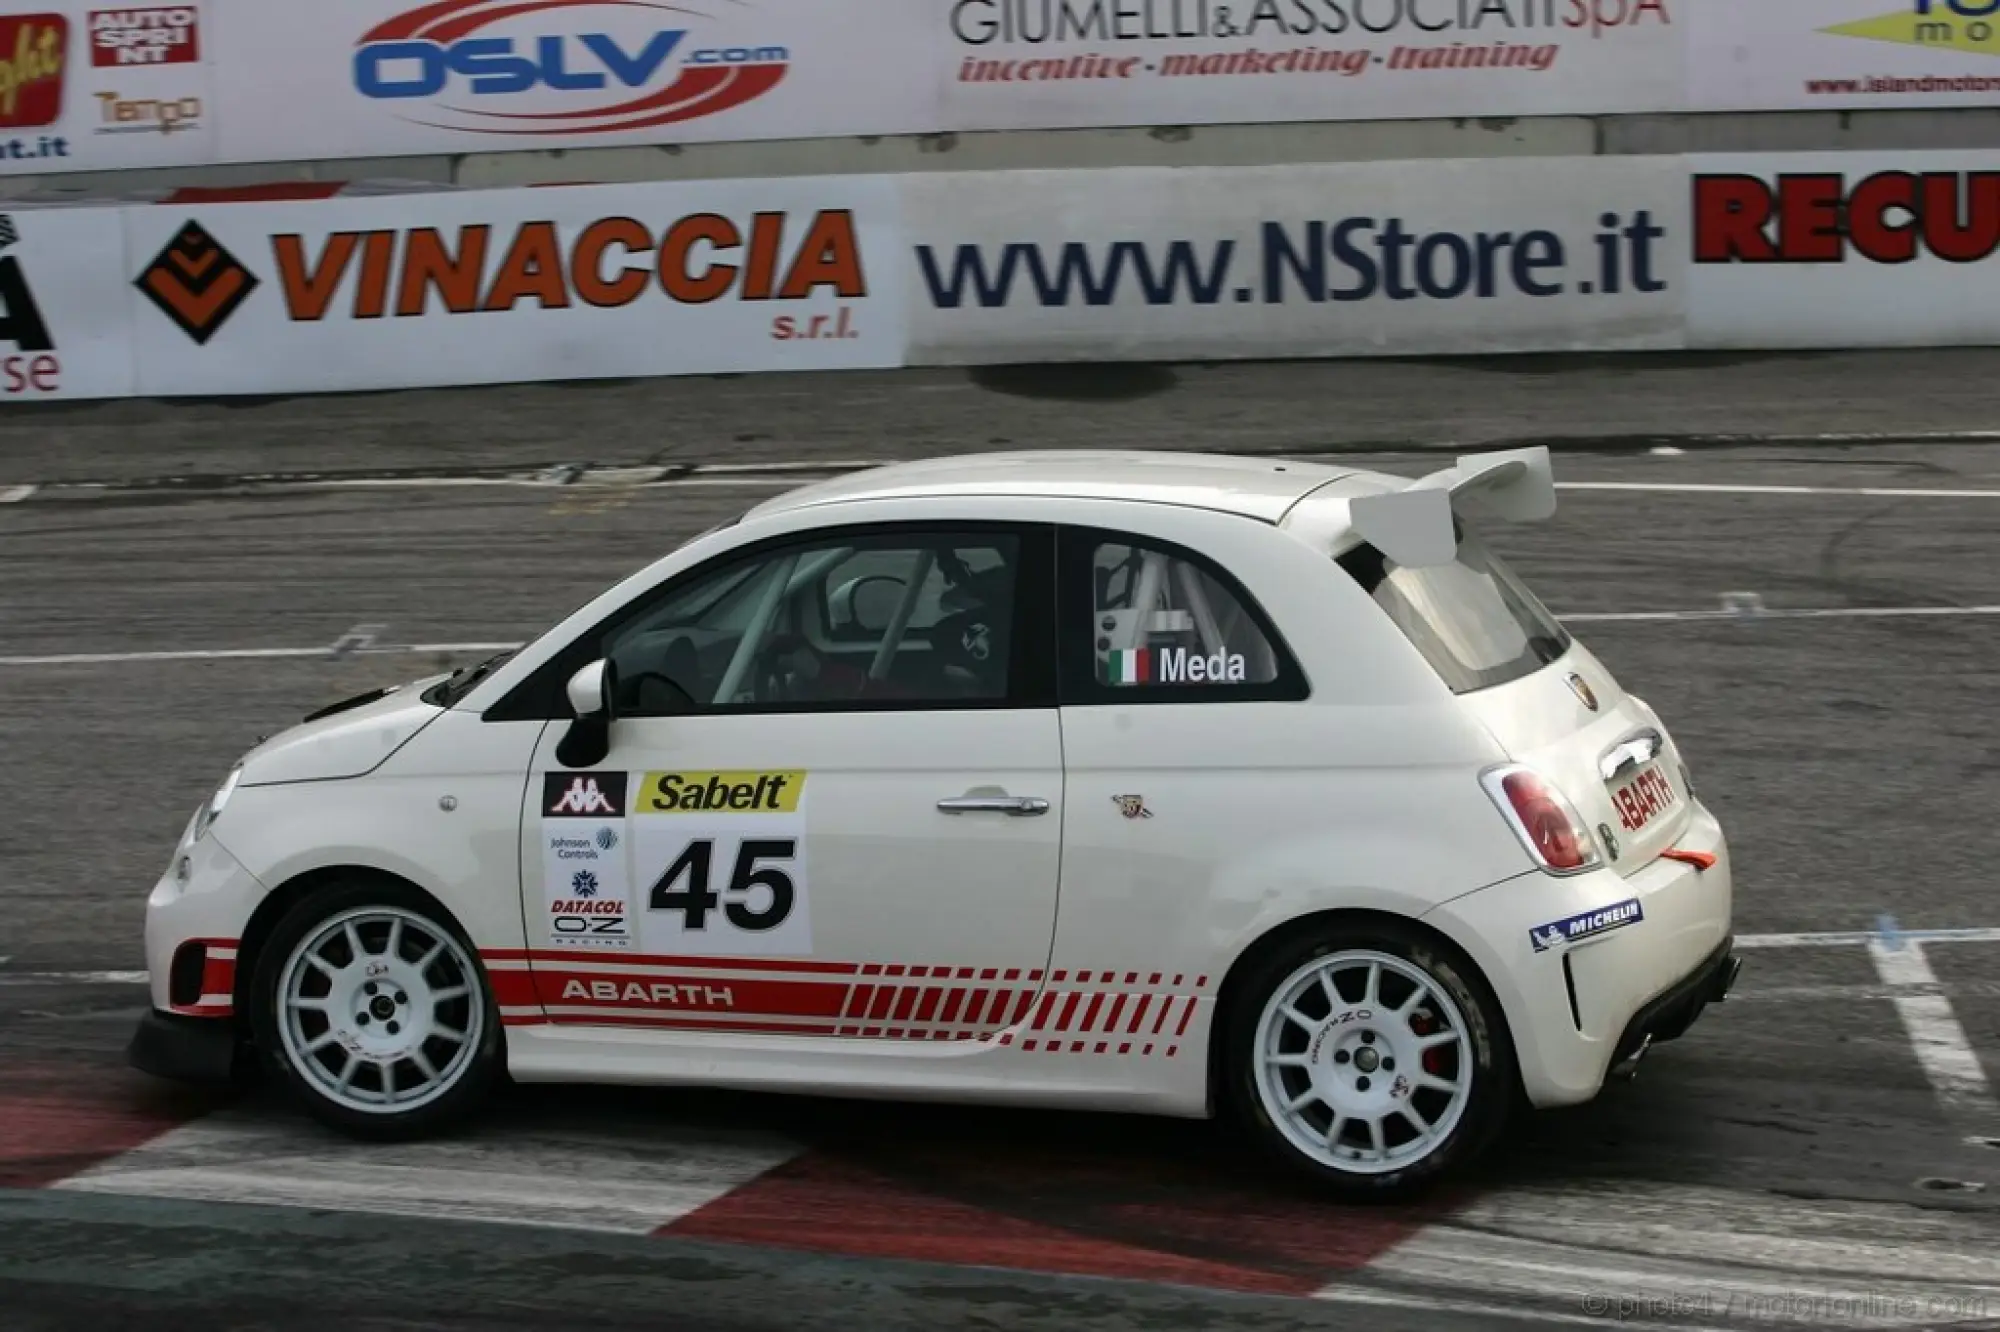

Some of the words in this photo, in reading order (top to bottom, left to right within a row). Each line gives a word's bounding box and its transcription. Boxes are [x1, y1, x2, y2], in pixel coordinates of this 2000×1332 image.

[92, 9, 194, 29] AUTO
[93, 27, 189, 47] SPRI
[116, 45, 168, 65] NT
[1691, 169, 2000, 264] RECU
[270, 208, 868, 322] VINACCIA
[914, 208, 1666, 308] www.NStore.it
[769, 306, 860, 340] s.r.l.
[0, 354, 60, 393] se
[1160, 645, 1246, 682] Meda
[651, 774, 788, 811] Sabelt
[1610, 764, 1675, 832] ABARTH
[550, 837, 591, 849] Johnson
[557, 849, 599, 860] Controls
[647, 836, 798, 932] 45
[550, 899, 625, 914] DATACOL
[1569, 901, 1639, 937] MICHELIN
[561, 979, 734, 1007] ABARTH
